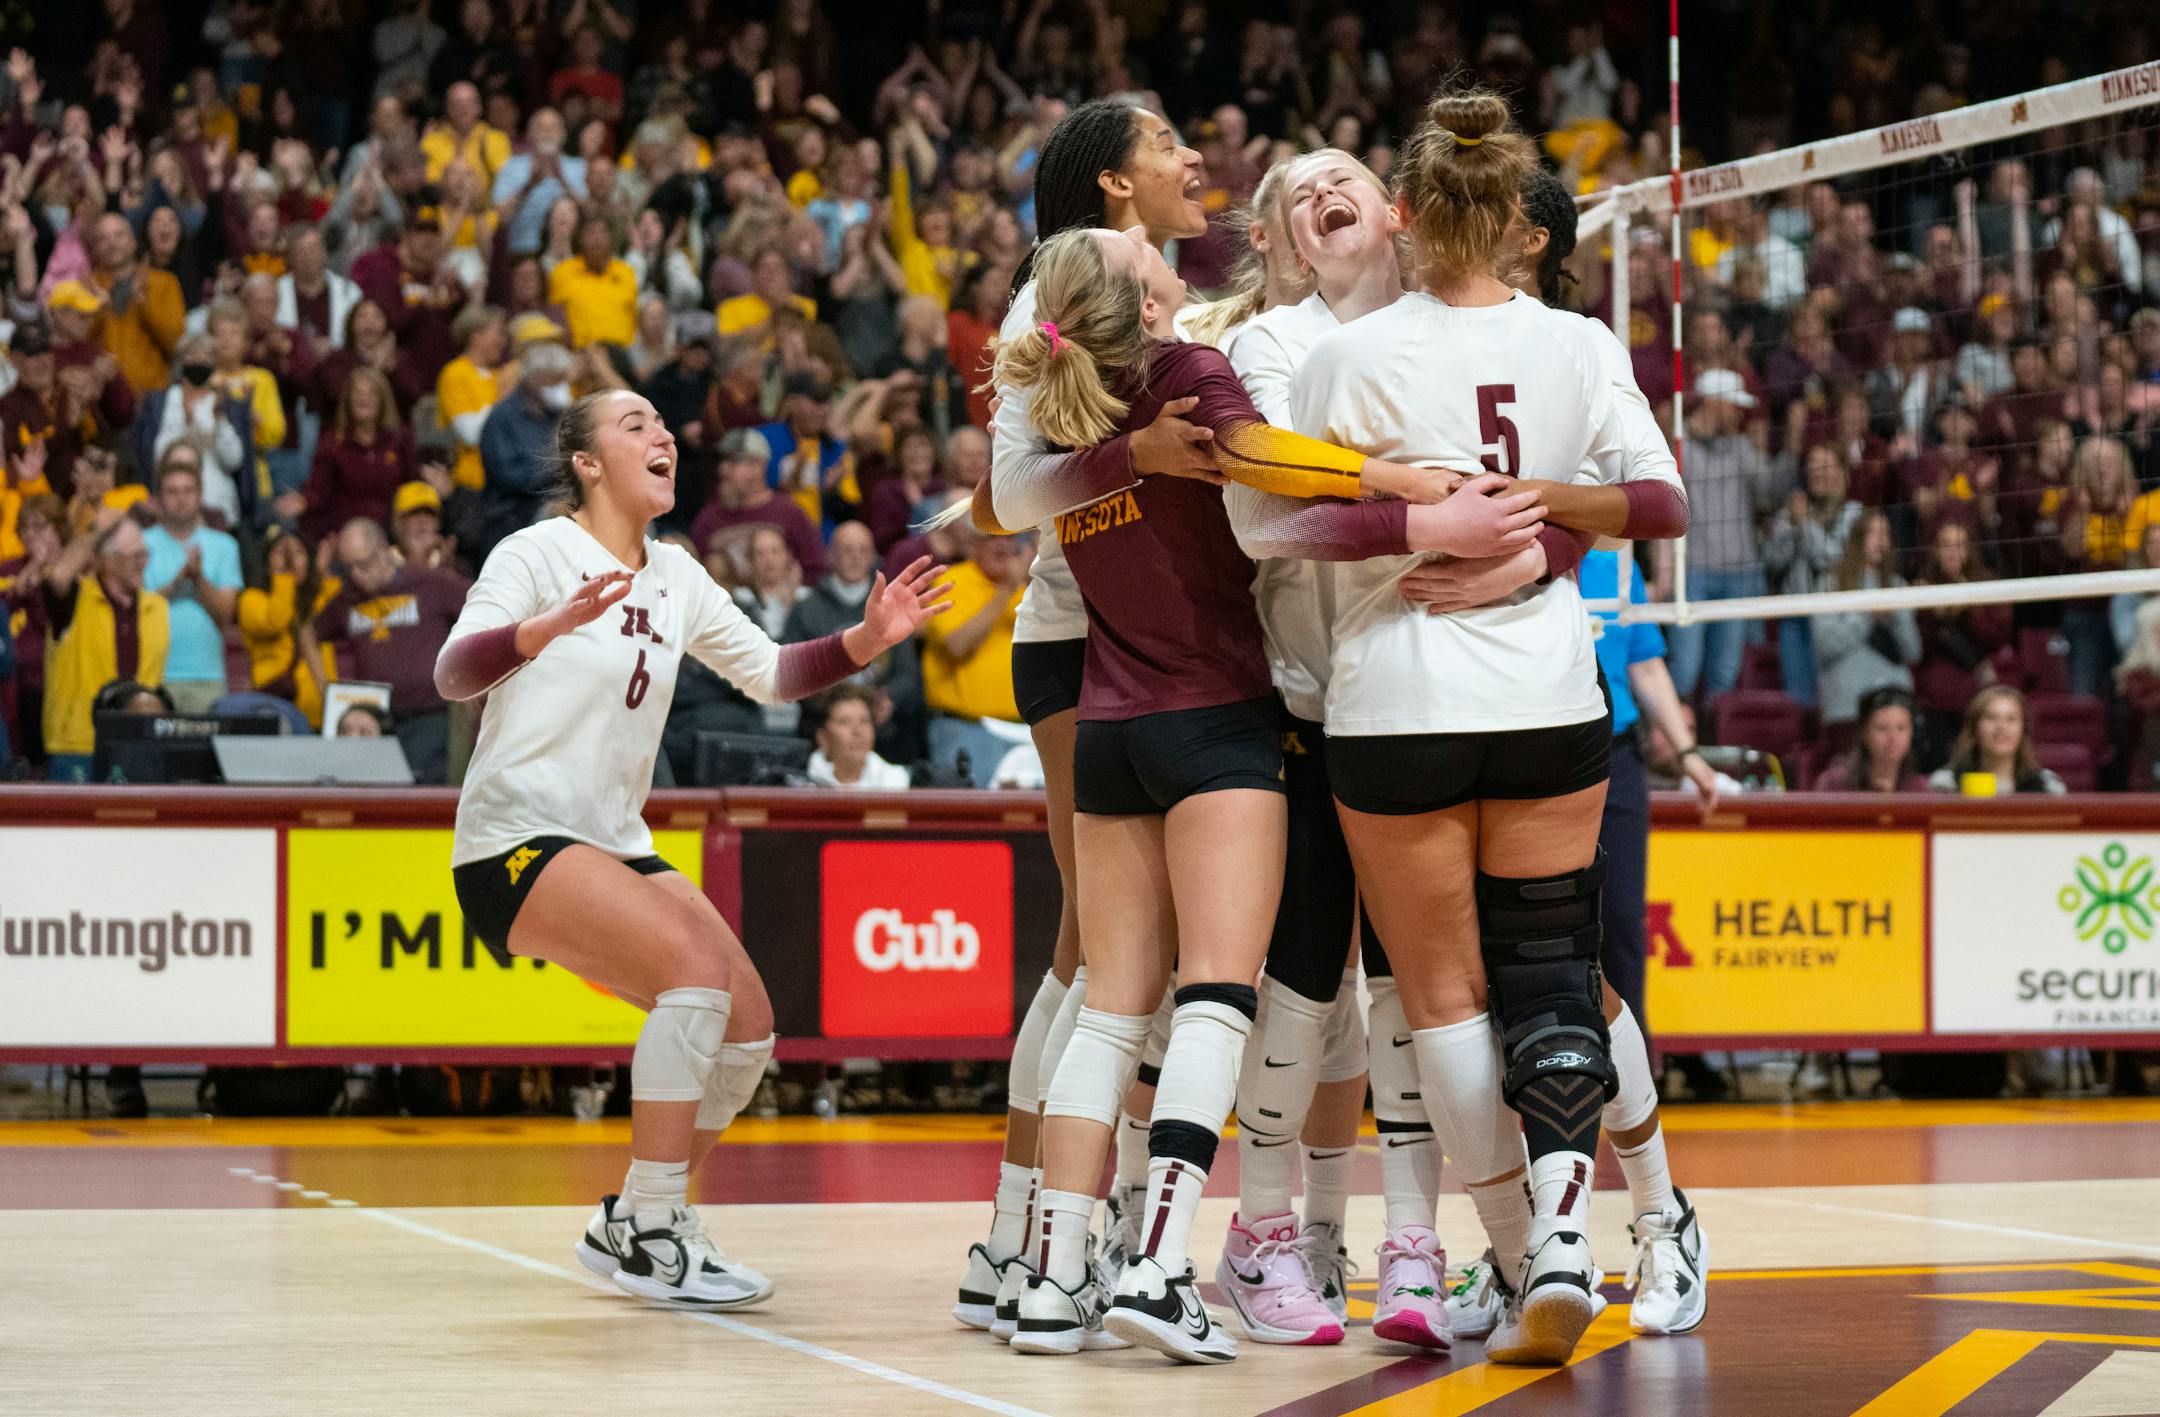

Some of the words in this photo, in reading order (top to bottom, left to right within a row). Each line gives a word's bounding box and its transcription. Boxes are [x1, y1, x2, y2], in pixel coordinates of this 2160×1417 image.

[2102, 65, 2160, 104] MINNESO
[1476, 384, 1520, 479] 5
[625, 647, 651, 710] 6
[0, 905, 252, 972] untington
[854, 907, 980, 972] Cub
[1714, 901, 1892, 937] HEALTH
[1714, 949, 1839, 968] FAIRVIEW
[2017, 969, 2160, 1001] securi
